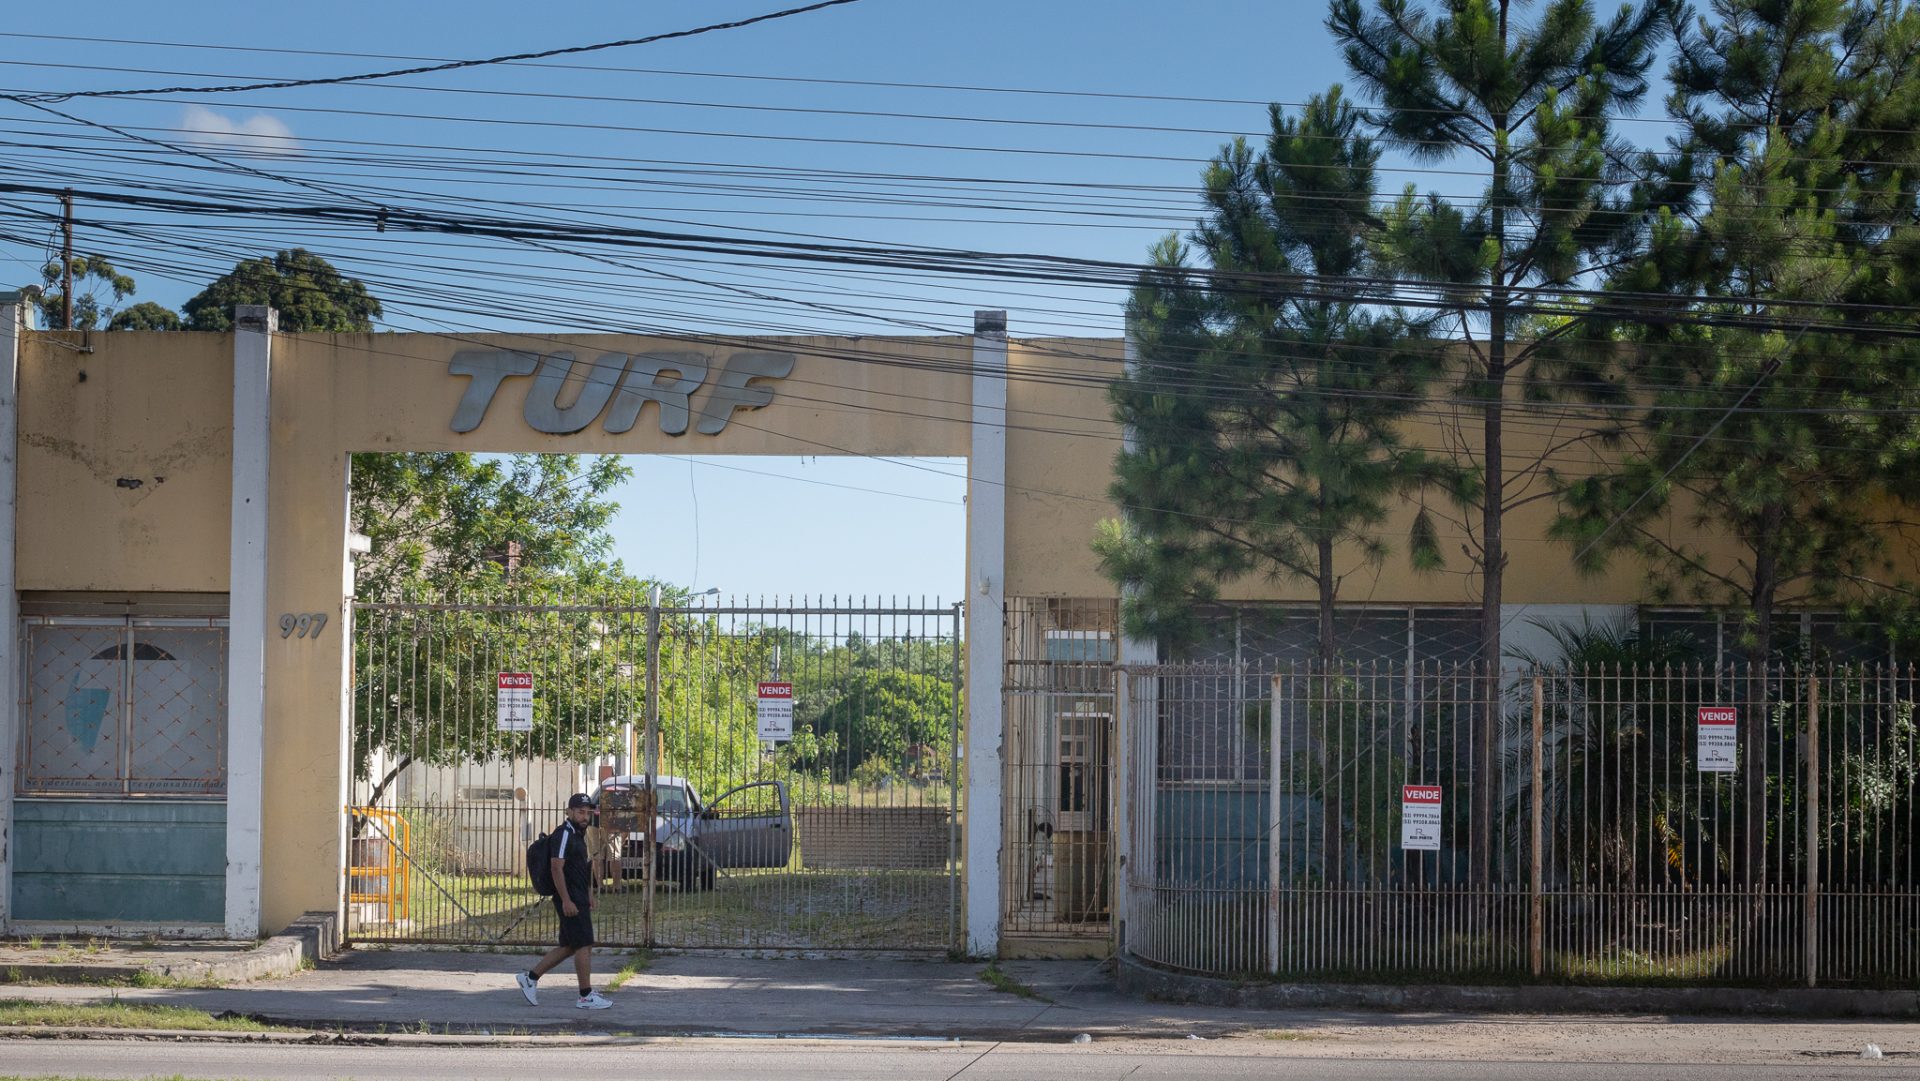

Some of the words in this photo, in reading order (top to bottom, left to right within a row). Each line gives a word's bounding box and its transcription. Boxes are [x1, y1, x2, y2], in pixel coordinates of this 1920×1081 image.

[448, 350, 796, 435] TURF
[279, 612, 328, 639] 997
[500, 676, 531, 685] VENDE
[760, 686, 791, 695] VENDE
[1700, 711, 1734, 721] VENDE
[1405, 789, 1440, 800] VENDE
